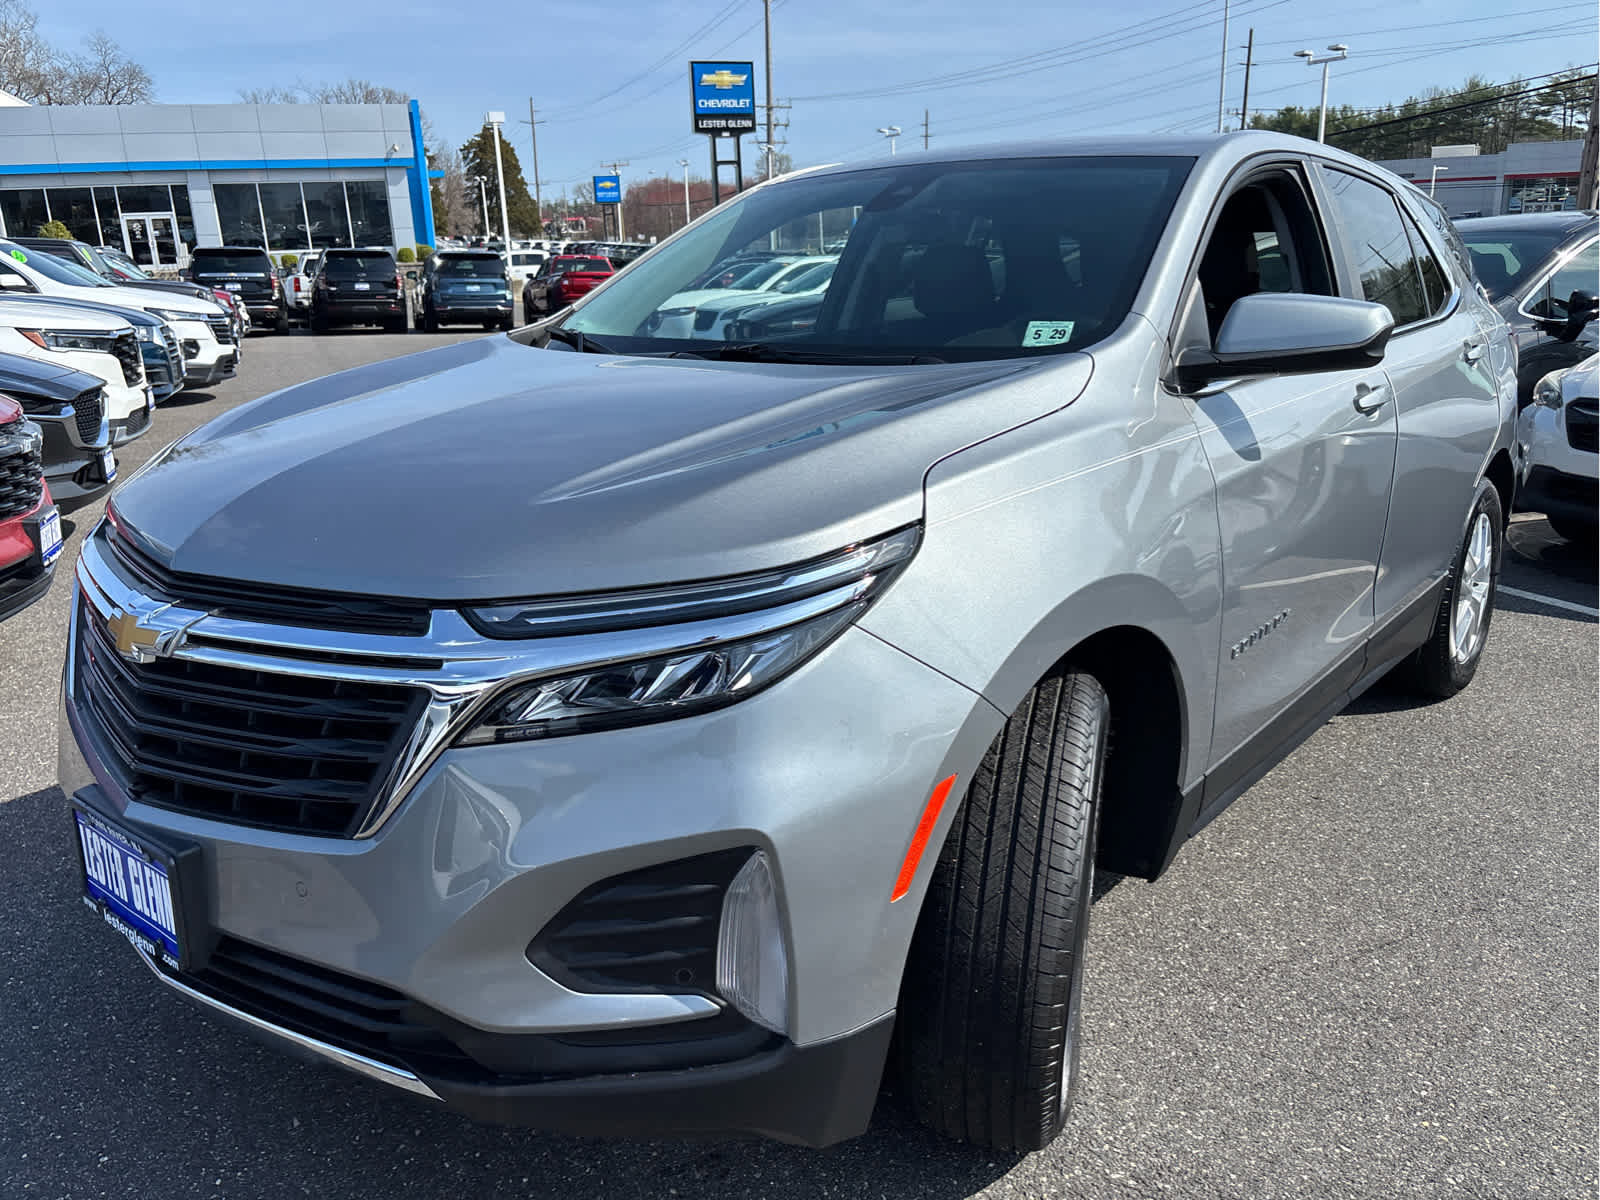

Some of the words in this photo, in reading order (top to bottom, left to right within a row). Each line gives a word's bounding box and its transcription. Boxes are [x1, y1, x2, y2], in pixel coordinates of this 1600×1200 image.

[698, 99, 751, 108] CHEVROLET
[698, 119, 727, 129] LESTER
[727, 119, 753, 128] GLENN
[1032, 329, 1043, 340] 5
[1049, 328, 1067, 340] 29
[78, 823, 129, 903] LESTER
[127, 855, 177, 936] GLENN
[103, 907, 156, 956] lesterglenn
